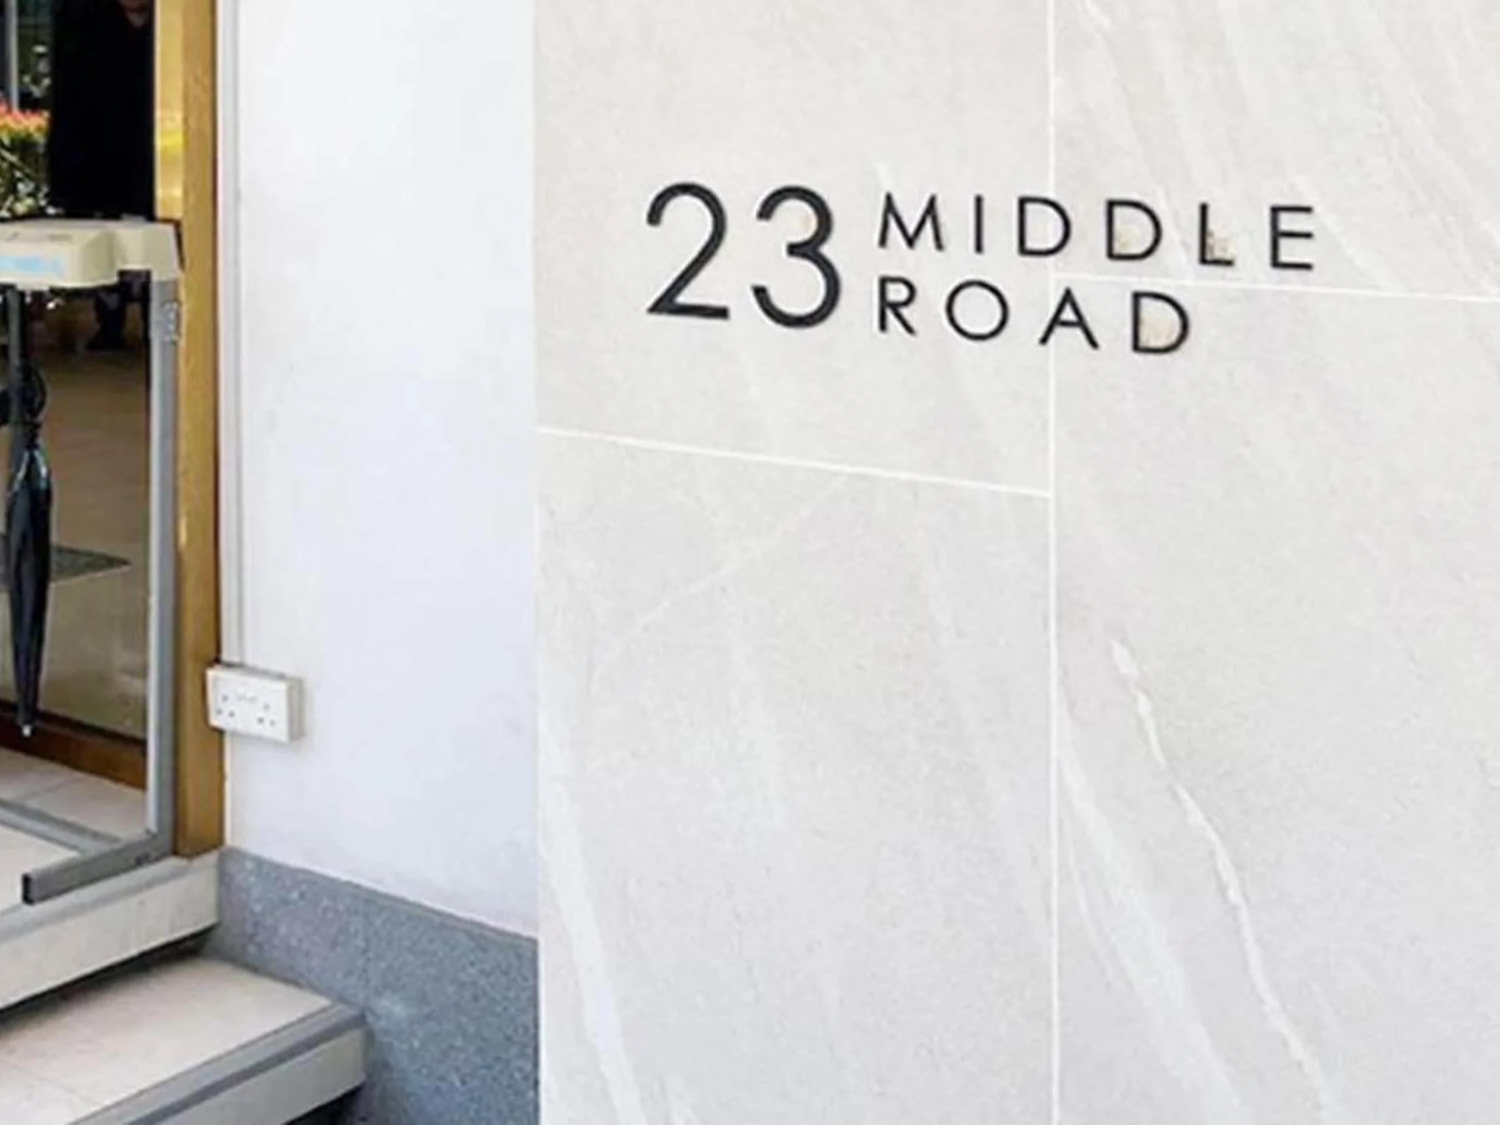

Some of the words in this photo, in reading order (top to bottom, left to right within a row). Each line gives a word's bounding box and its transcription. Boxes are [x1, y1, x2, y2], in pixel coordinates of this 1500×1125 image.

[646, 181, 842, 330] 23
[877, 191, 1315, 272] MIDDLE
[877, 274, 1191, 355] ROAD
